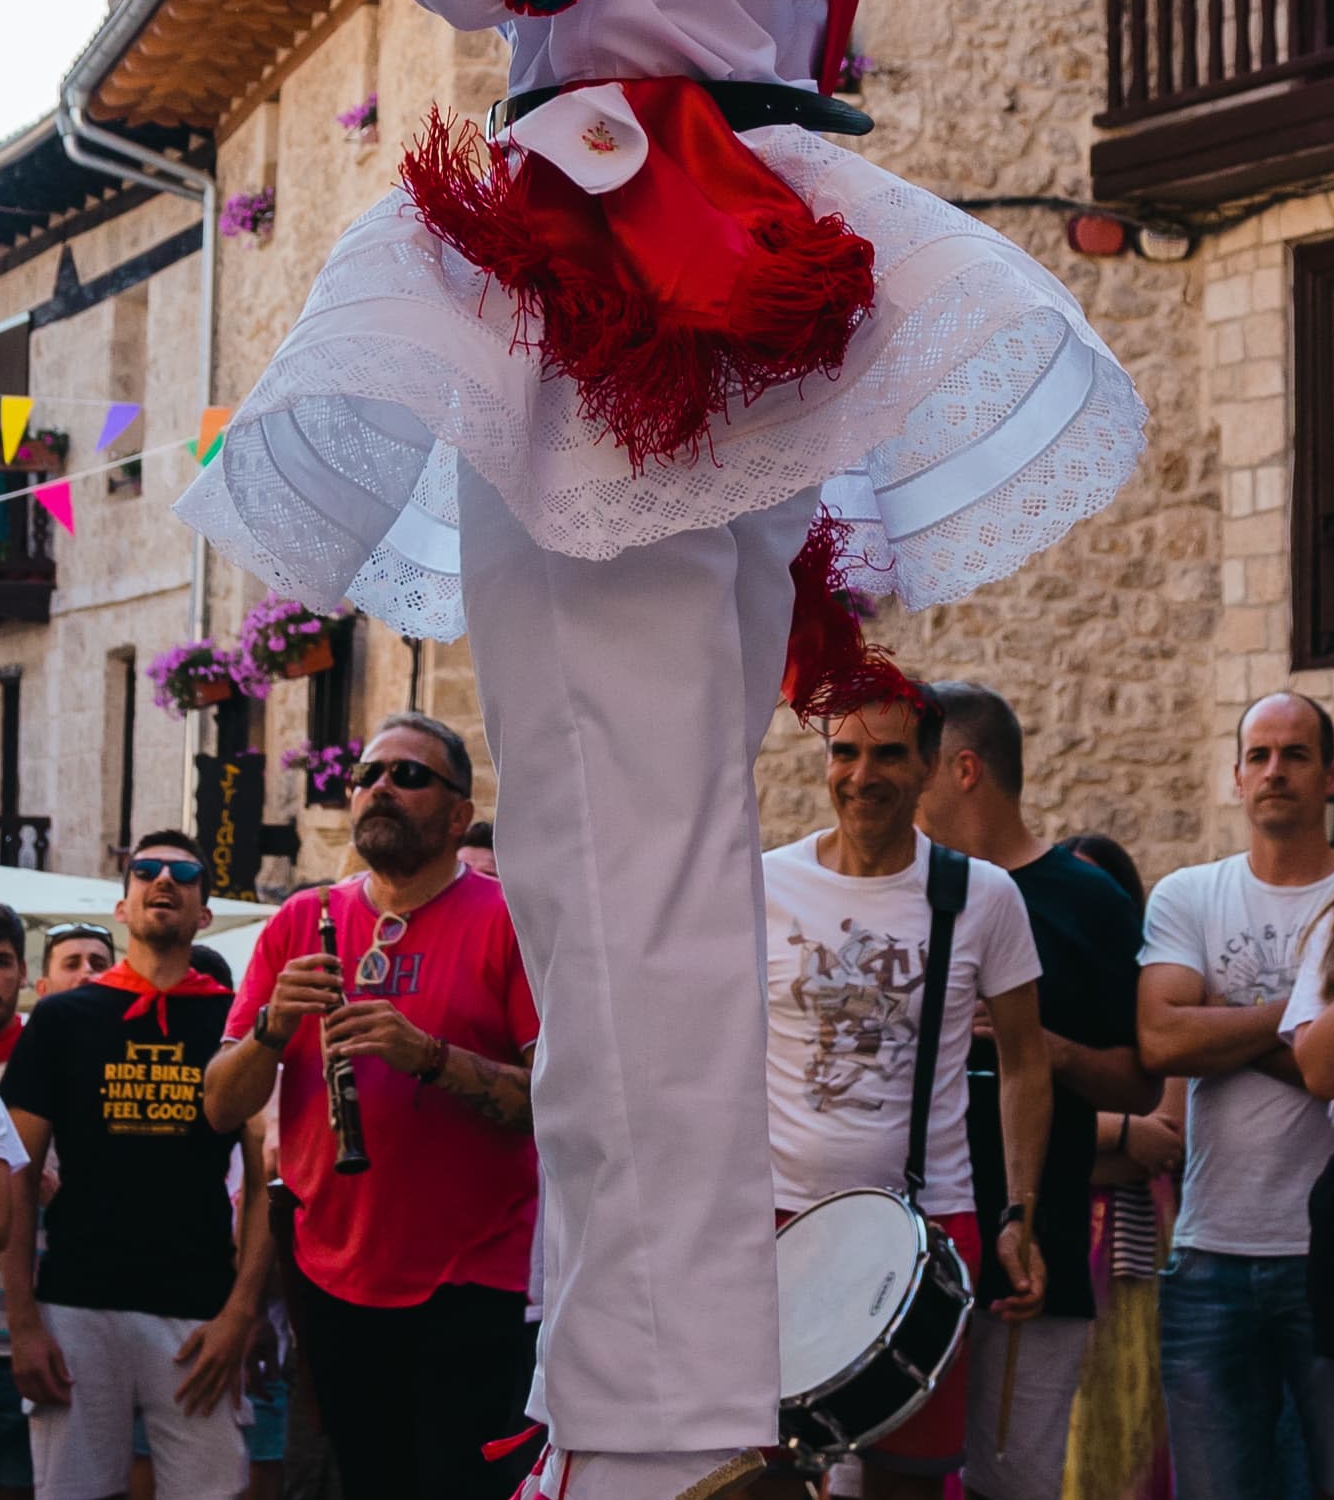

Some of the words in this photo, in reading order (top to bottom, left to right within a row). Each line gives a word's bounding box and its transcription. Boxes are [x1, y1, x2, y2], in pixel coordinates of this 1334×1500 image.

[104, 1063, 146, 1080] RIDE
[150, 1064, 201, 1083] BIKES
[108, 1082, 156, 1100] HAVE
[159, 1083, 195, 1102] FUN
[103, 1101, 142, 1119] FEEL
[147, 1103, 197, 1121] GOOD
